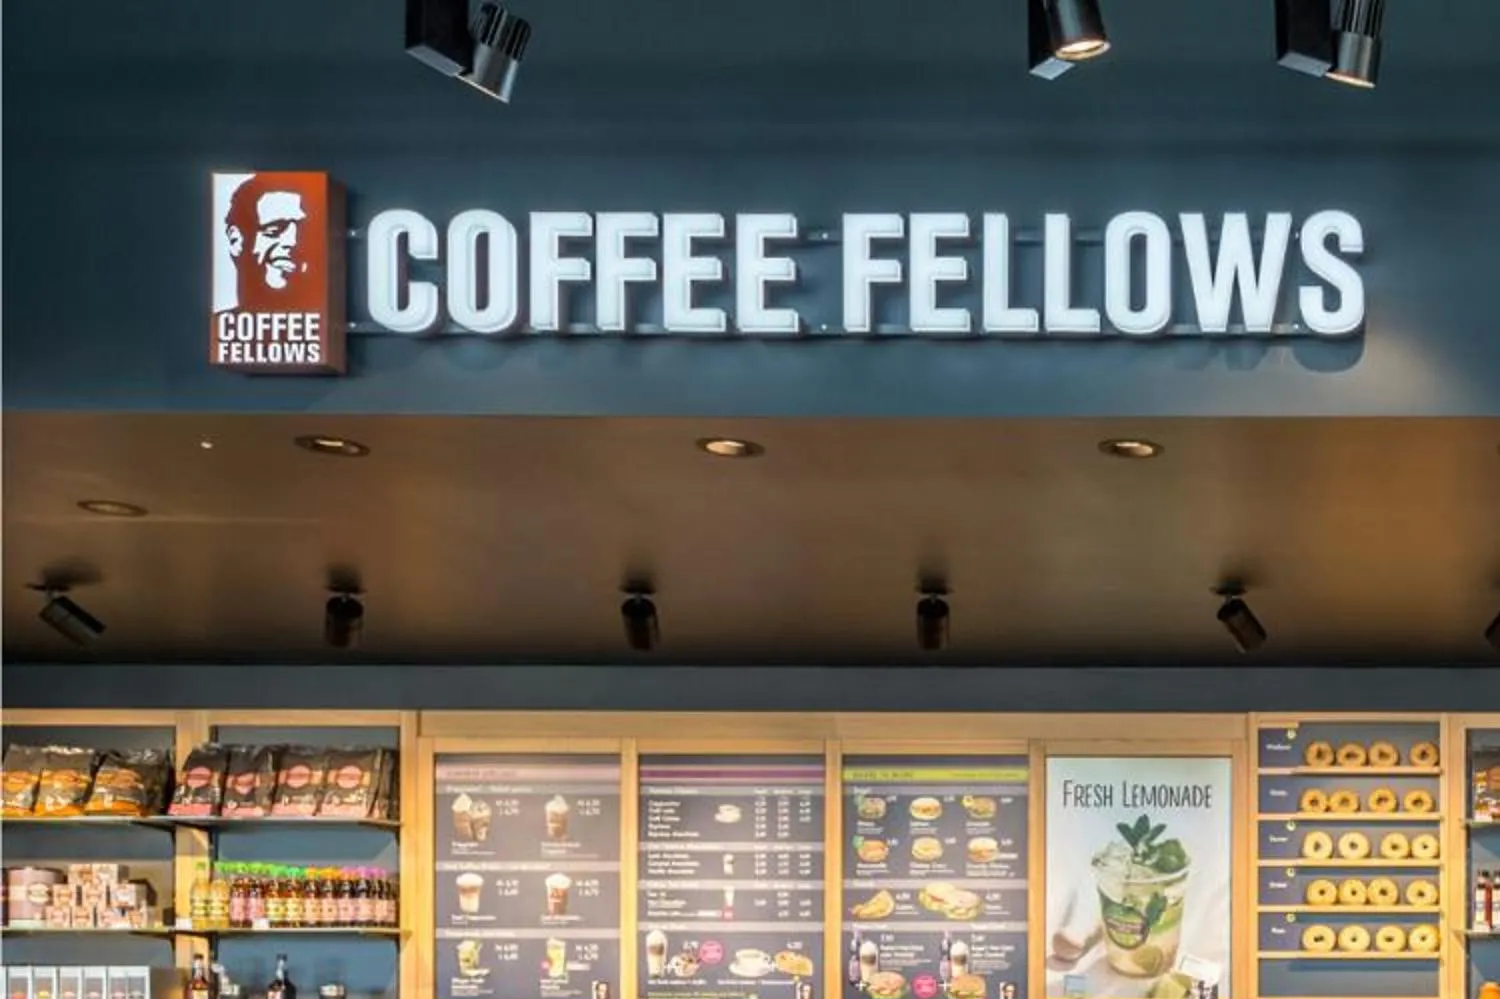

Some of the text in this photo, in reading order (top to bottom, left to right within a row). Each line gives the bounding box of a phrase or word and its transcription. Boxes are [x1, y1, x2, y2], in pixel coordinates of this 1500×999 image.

[366, 209, 1366, 337] COFFEE FELLOWS
[218, 313, 321, 341] COFFEE
[217, 342, 321, 363] FELLOWS
[1062, 779, 1212, 809] FRESH LEMONADE
